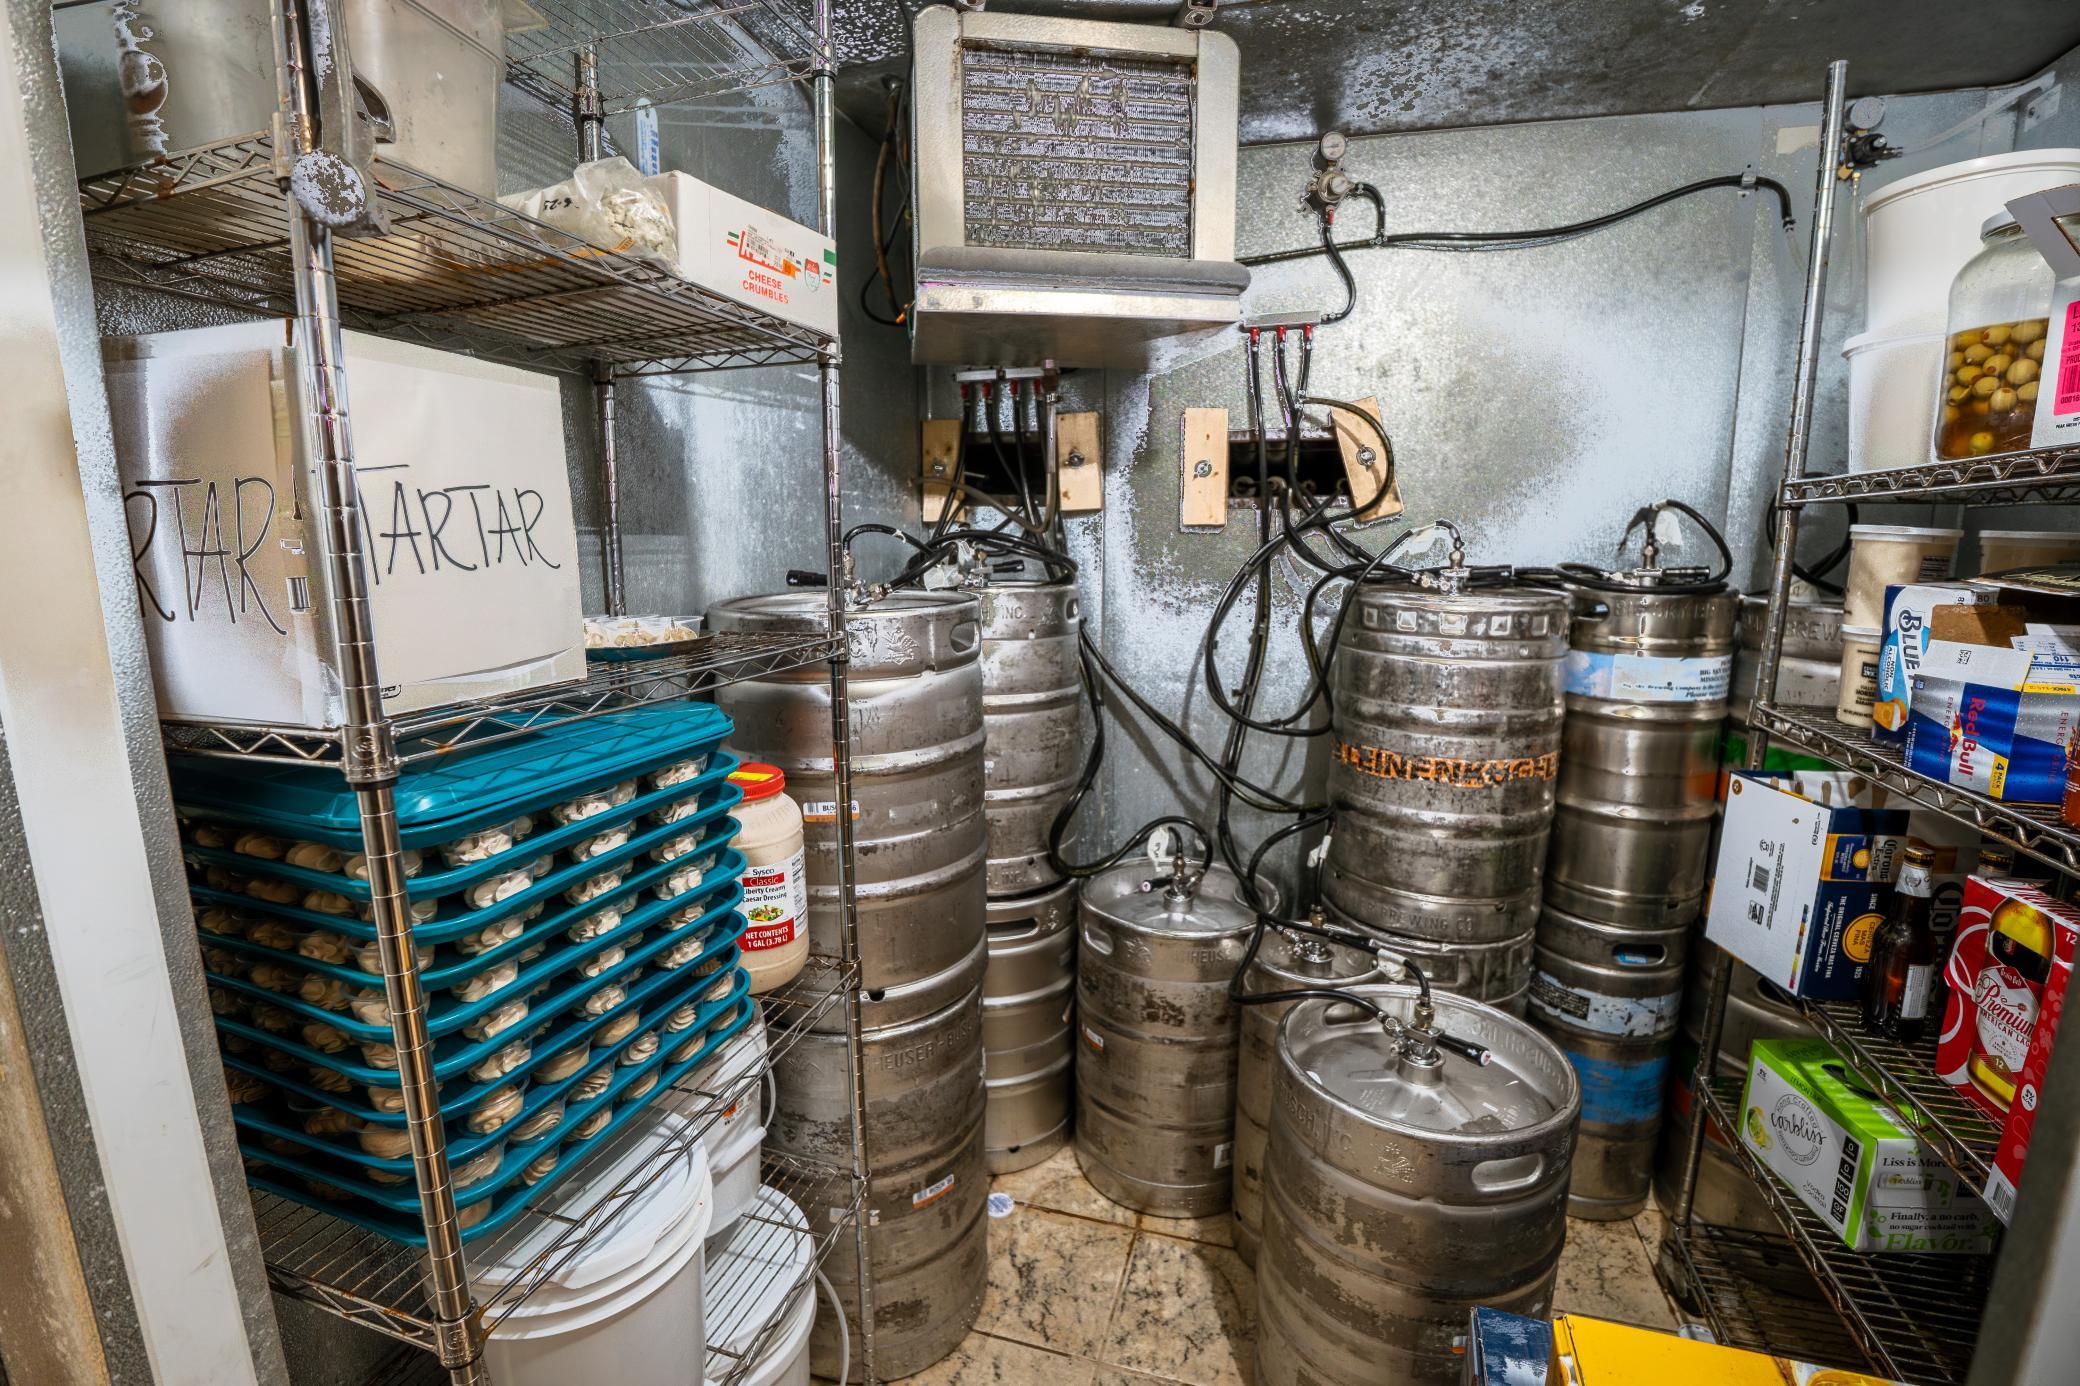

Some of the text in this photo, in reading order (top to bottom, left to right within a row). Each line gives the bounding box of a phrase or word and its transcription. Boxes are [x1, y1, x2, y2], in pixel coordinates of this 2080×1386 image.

[748, 270, 782, 290] CHEESE
[743, 280, 789, 304] CRUMBLES
[1899, 609, 1923, 670] BLUE
[1884, 646, 1893, 691] ALCOHOLIC
[1958, 697, 1986, 777] Red Bull
[1995, 762, 2004, 771] 4
[1871, 848, 1881, 871] Extra
[1880, 839, 1898, 880] Corona
[753, 868, 774, 877] Sysco
[750, 876, 779, 887] Classic
[765, 885, 786, 893] Creamy
[763, 892, 787, 901] Dressing
[1869, 893, 1878, 910] SINCE
[1833, 906, 1845, 931] ORIGINAL
[746, 926, 788, 940] NET CONTENTS
[1852, 929, 1860, 945] FINA
[1859, 929, 1867, 945] MAS
[1864, 921, 1876, 953] CERVEZA
[2065, 932, 2078, 945] 12
[753, 939, 766, 947] GAL
[1830, 931, 1841, 954] CERVEZA
[1825, 966, 1834, 979] FINA
[1995, 1057, 2004, 1069] 12
[1771, 1112, 1828, 1146] carbliss
[1883, 1157, 1905, 1167] Liss
[1906, 1158, 1916, 1167] is
[1836, 1181, 1849, 1197] 100
[1954, 1213, 1980, 1222] carb,
[1885, 1233, 1973, 1250] Flavor.
